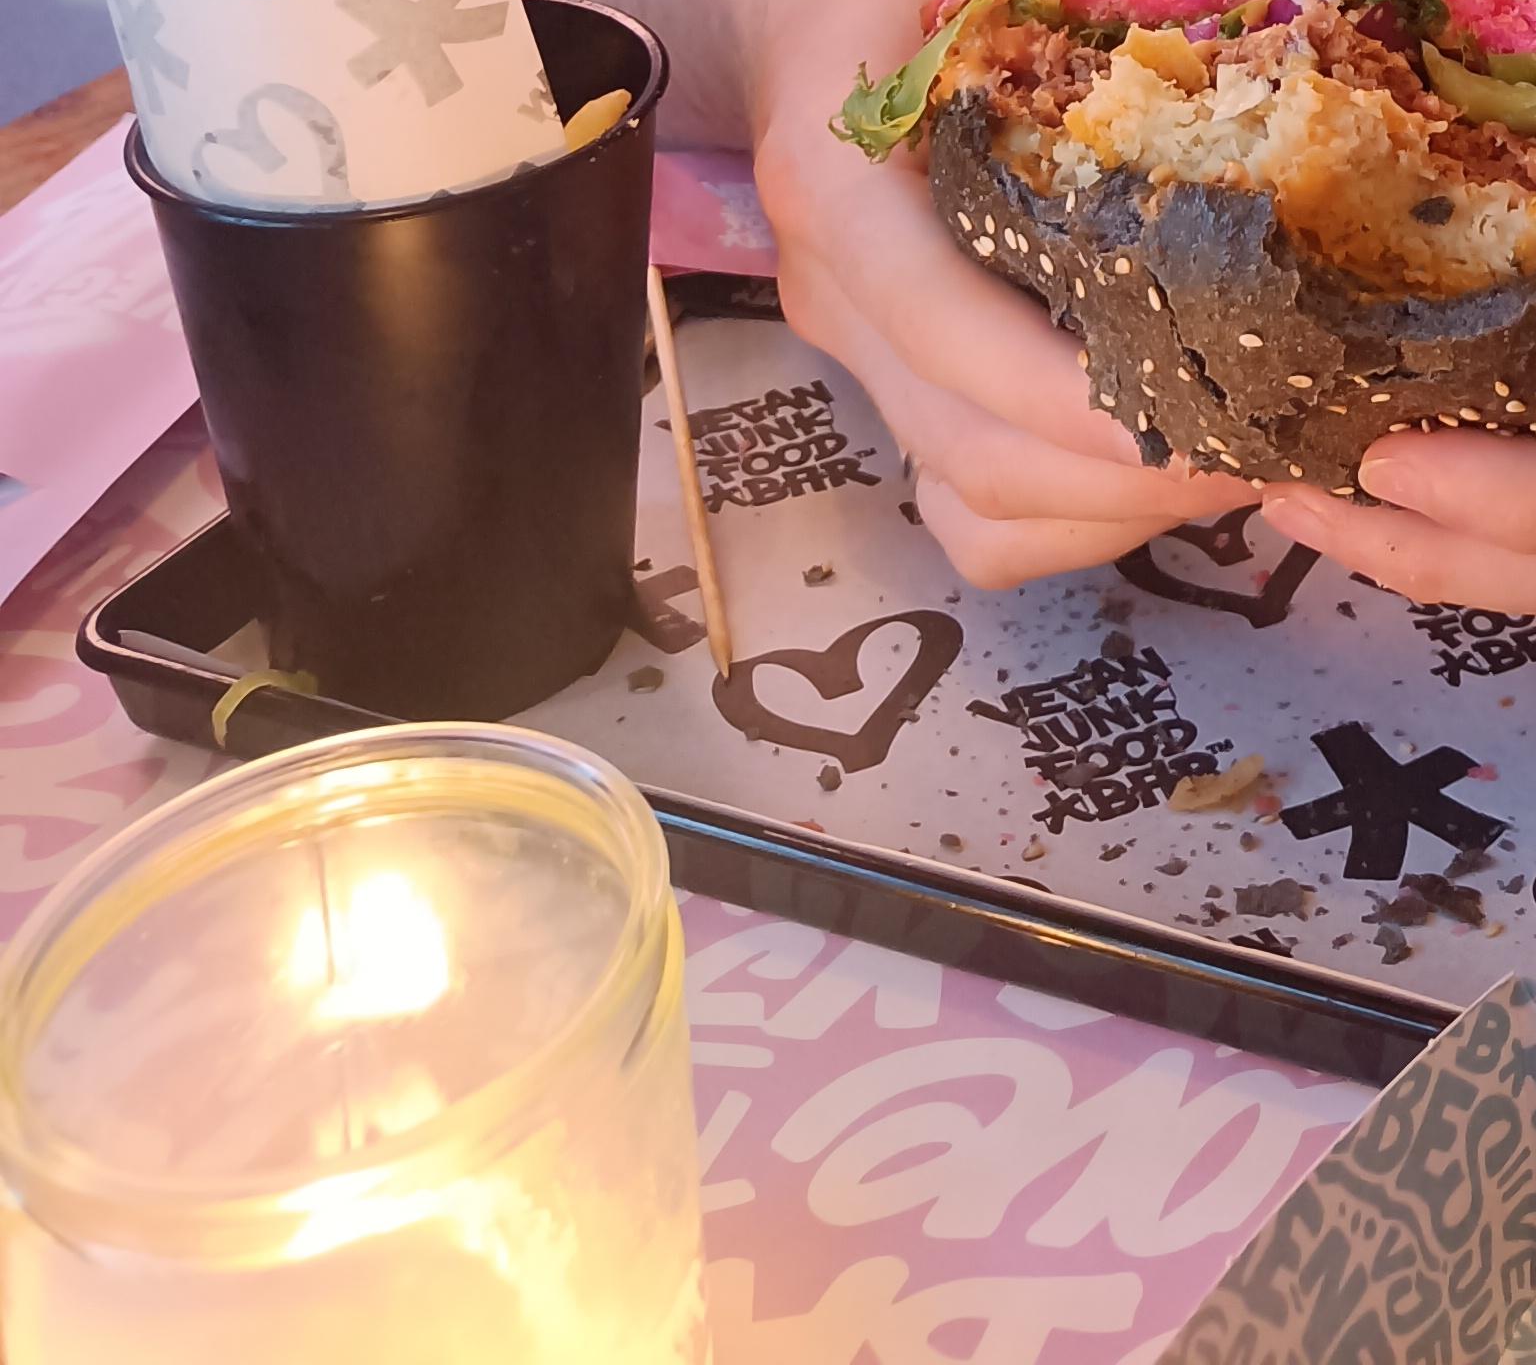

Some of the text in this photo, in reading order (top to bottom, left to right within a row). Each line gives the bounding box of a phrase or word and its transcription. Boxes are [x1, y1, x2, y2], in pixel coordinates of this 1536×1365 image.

[696, 432, 847, 483] FOOD
[697, 408, 833, 456] JUNK
[965, 646, 1172, 728] VEGAN
[1021, 684, 1177, 752] JUNK
[1025, 719, 1198, 791] FOOD
